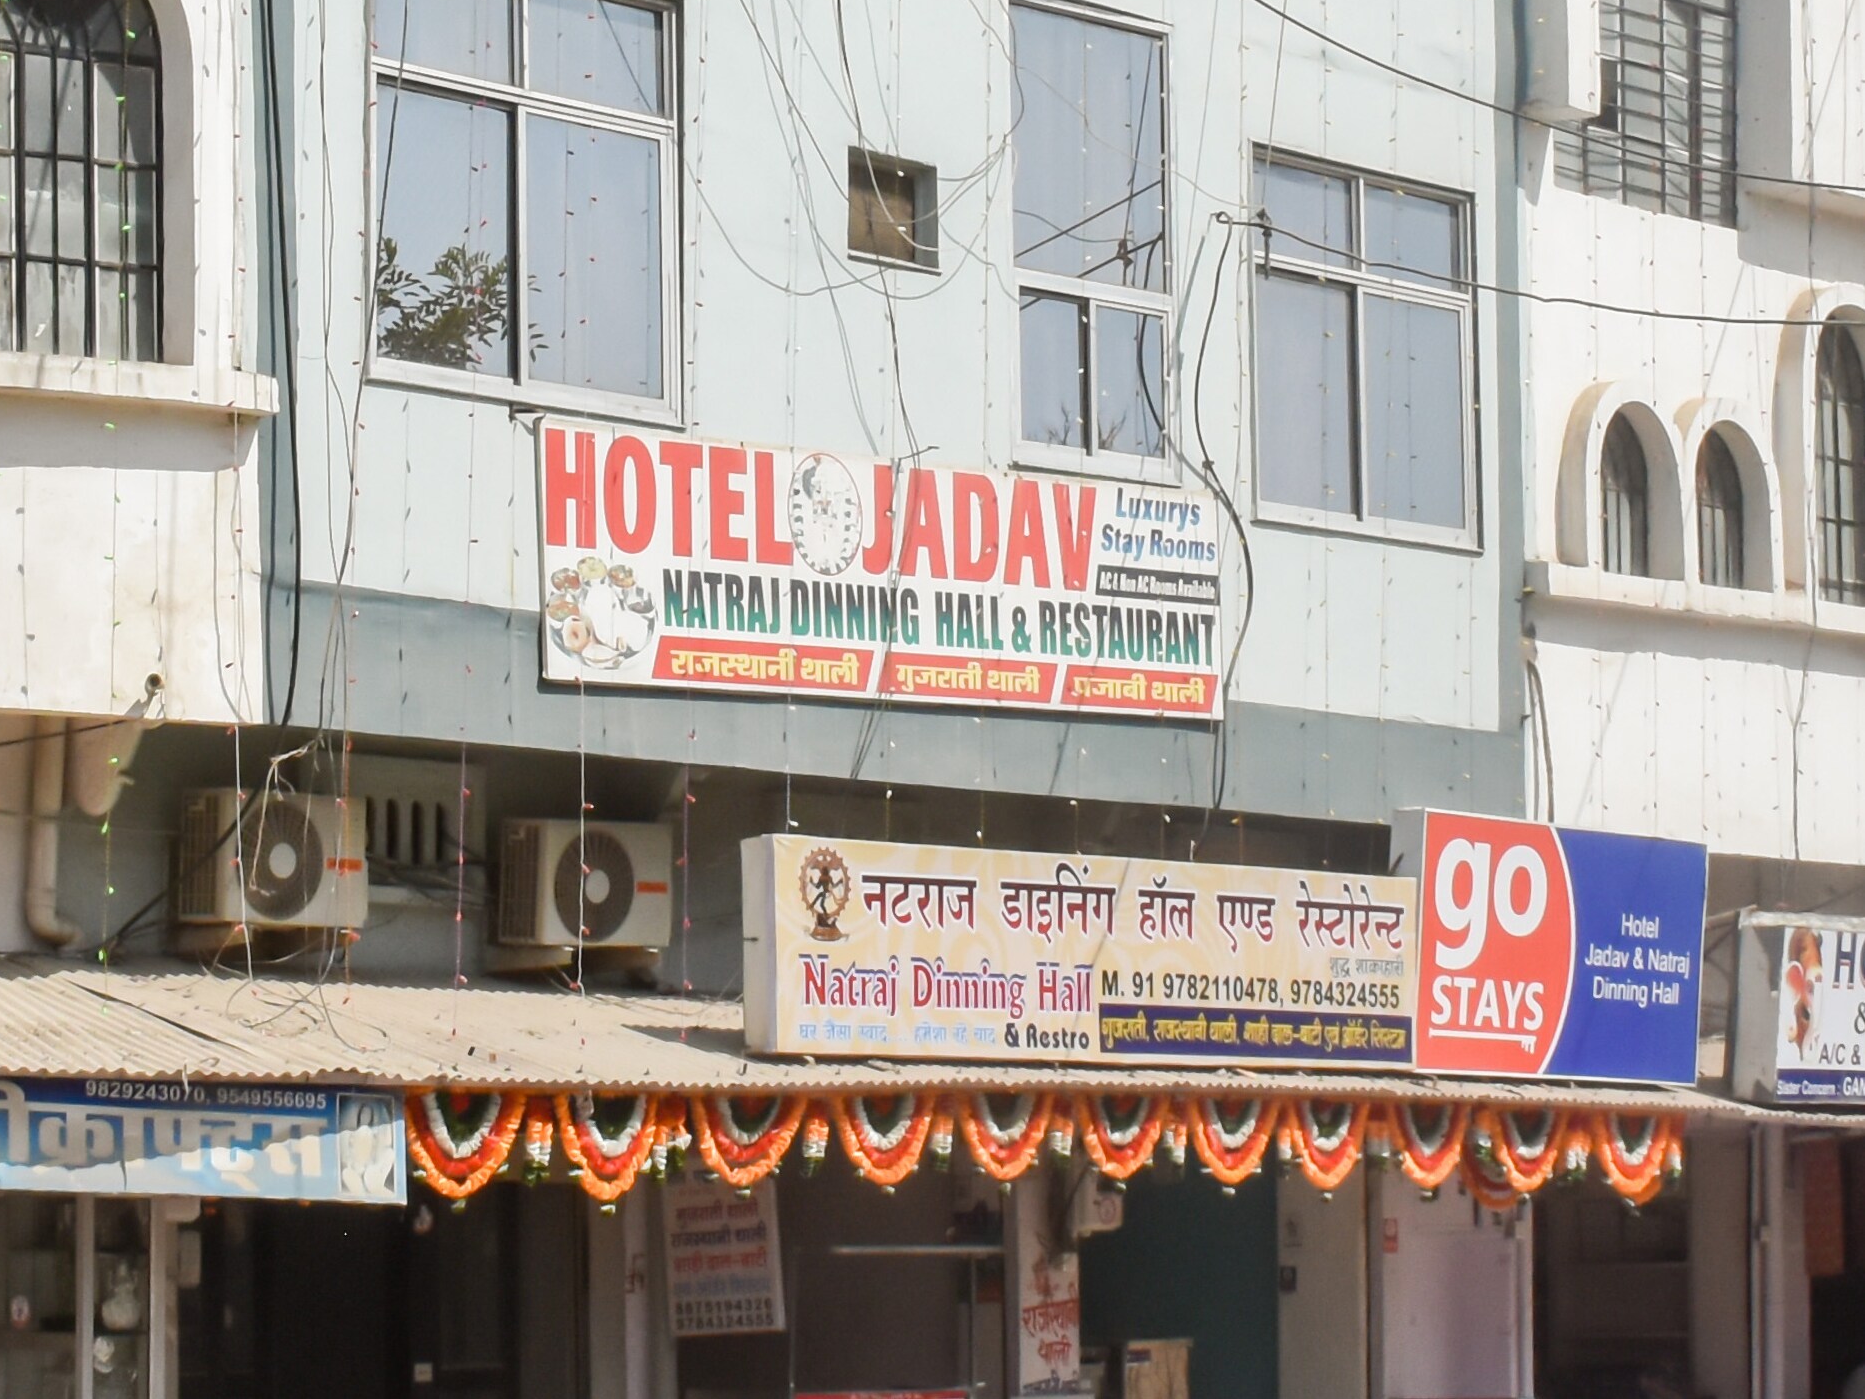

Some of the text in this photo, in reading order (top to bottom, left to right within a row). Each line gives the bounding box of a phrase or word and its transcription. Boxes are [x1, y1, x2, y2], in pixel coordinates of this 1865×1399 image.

[545, 428, 1097, 592] HOTEL JADAV
[1115, 487, 1201, 533] Luxurys
[1101, 523, 1216, 562] Stay Rooms
[662, 568, 1216, 667] NATRAJ DINNING HALL & RESTAURANT
[670, 648, 860, 685] राजस्थानी थाली
[895, 661, 1041, 694] गुजराती थाली
[1151, 677, 1206, 705] थाली
[861, 861, 1405, 954] नटराज डाइनिंग हॉल एण्ड रेस्टोरेन्ट
[1434, 837, 1548, 971] go
[1621, 912, 1660, 939] Hotel
[1584, 942, 1691, 980] Jadav & Natraj
[799, 953, 1094, 1020] Natraj Dinning Hall
[1102, 969, 1400, 1009] M. 91 9782110478, 9784324555
[1431, 974, 1545, 1032] STAYS
[1592, 975, 1680, 1009] Dinning Hall
[1004, 1023, 1090, 1050] & Restro
[1819, 1043, 1861, 1066] A/C &
